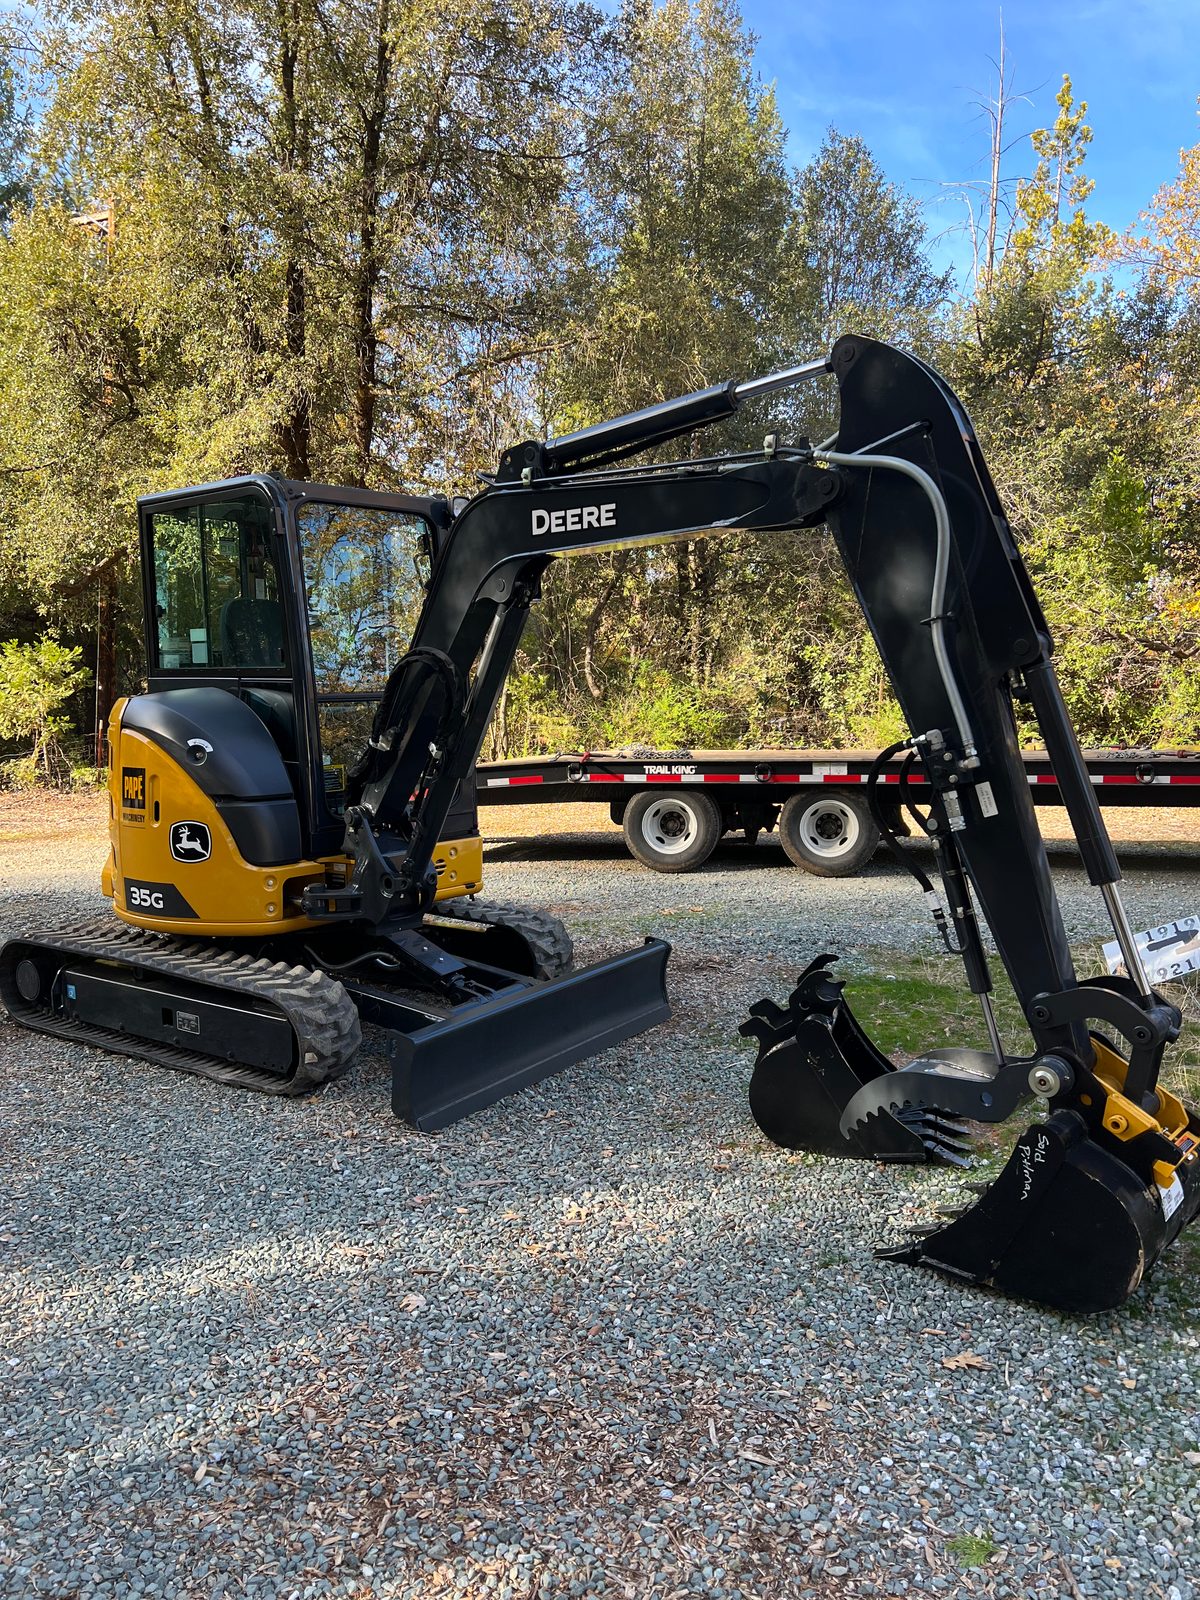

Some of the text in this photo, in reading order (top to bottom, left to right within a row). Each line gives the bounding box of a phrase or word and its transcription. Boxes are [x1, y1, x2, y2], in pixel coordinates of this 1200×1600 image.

[531, 503, 617, 536] DEERE
[643, 765, 696, 774] TRAIL KING
[130, 886, 164, 909] 35G
[1145, 917, 1196, 943] 1919
[1034, 1133, 1049, 1163] Sold
